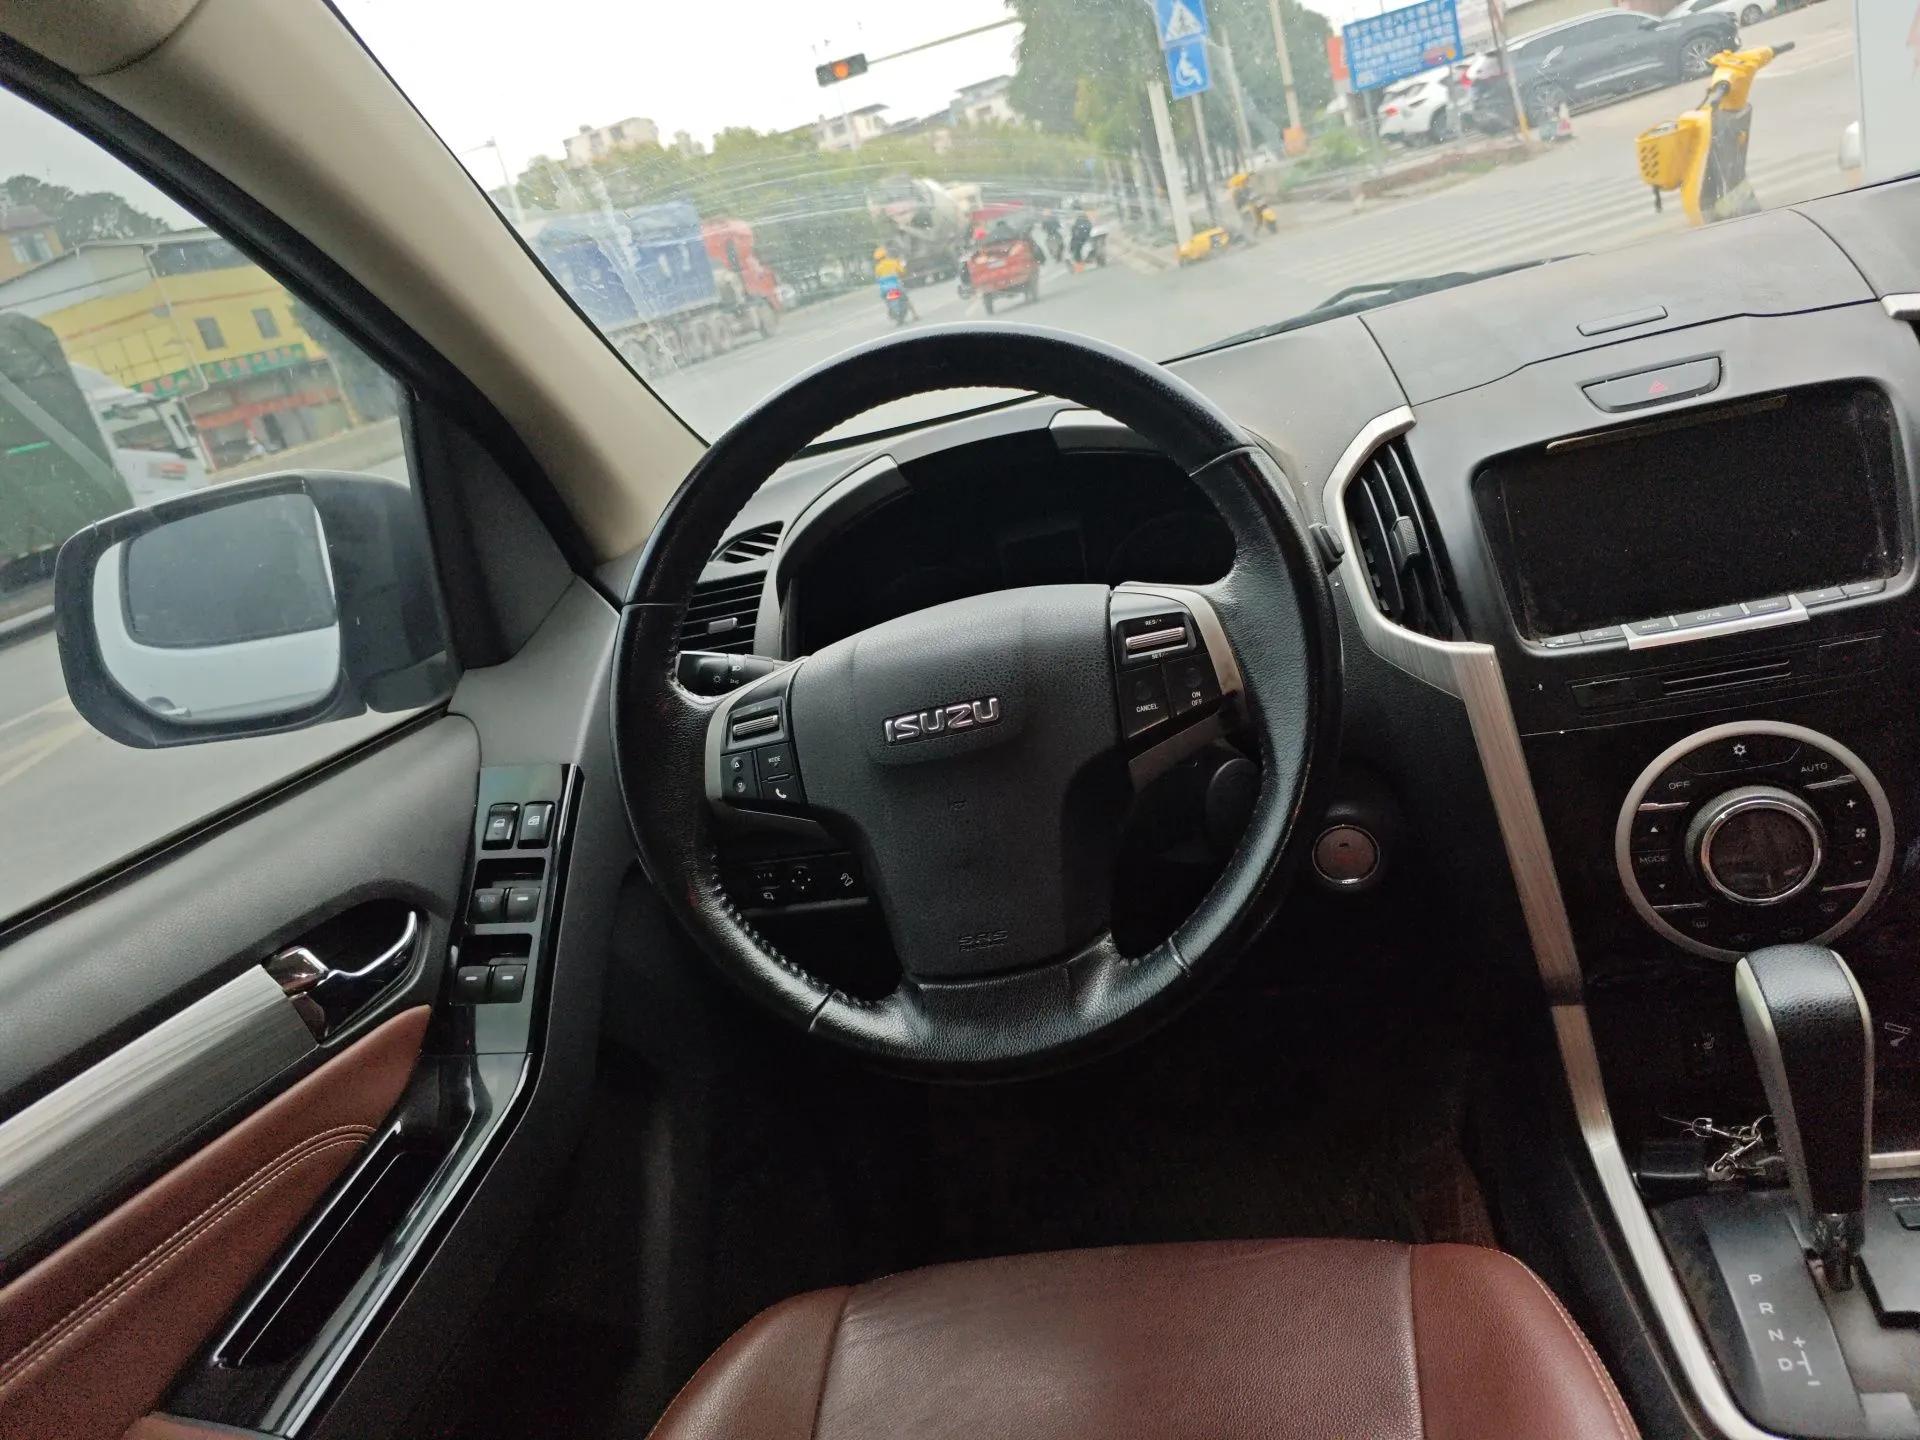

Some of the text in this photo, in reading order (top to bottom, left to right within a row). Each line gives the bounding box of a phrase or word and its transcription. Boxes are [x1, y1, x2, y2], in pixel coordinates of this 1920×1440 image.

[1136, 703, 1159, 713] CANCEL
[1191, 698, 1203, 707] OFF
[885, 698, 999, 742] ISUZU
[1801, 762, 1828, 773] AUTO
[1668, 780, 1691, 790] OFF
[1639, 855, 1666, 864] MODE
[1748, 1274, 1762, 1285] P
[1759, 1302, 1775, 1314] R
[1768, 1329, 1784, 1341] N
[1777, 1358, 1793, 1371] D
